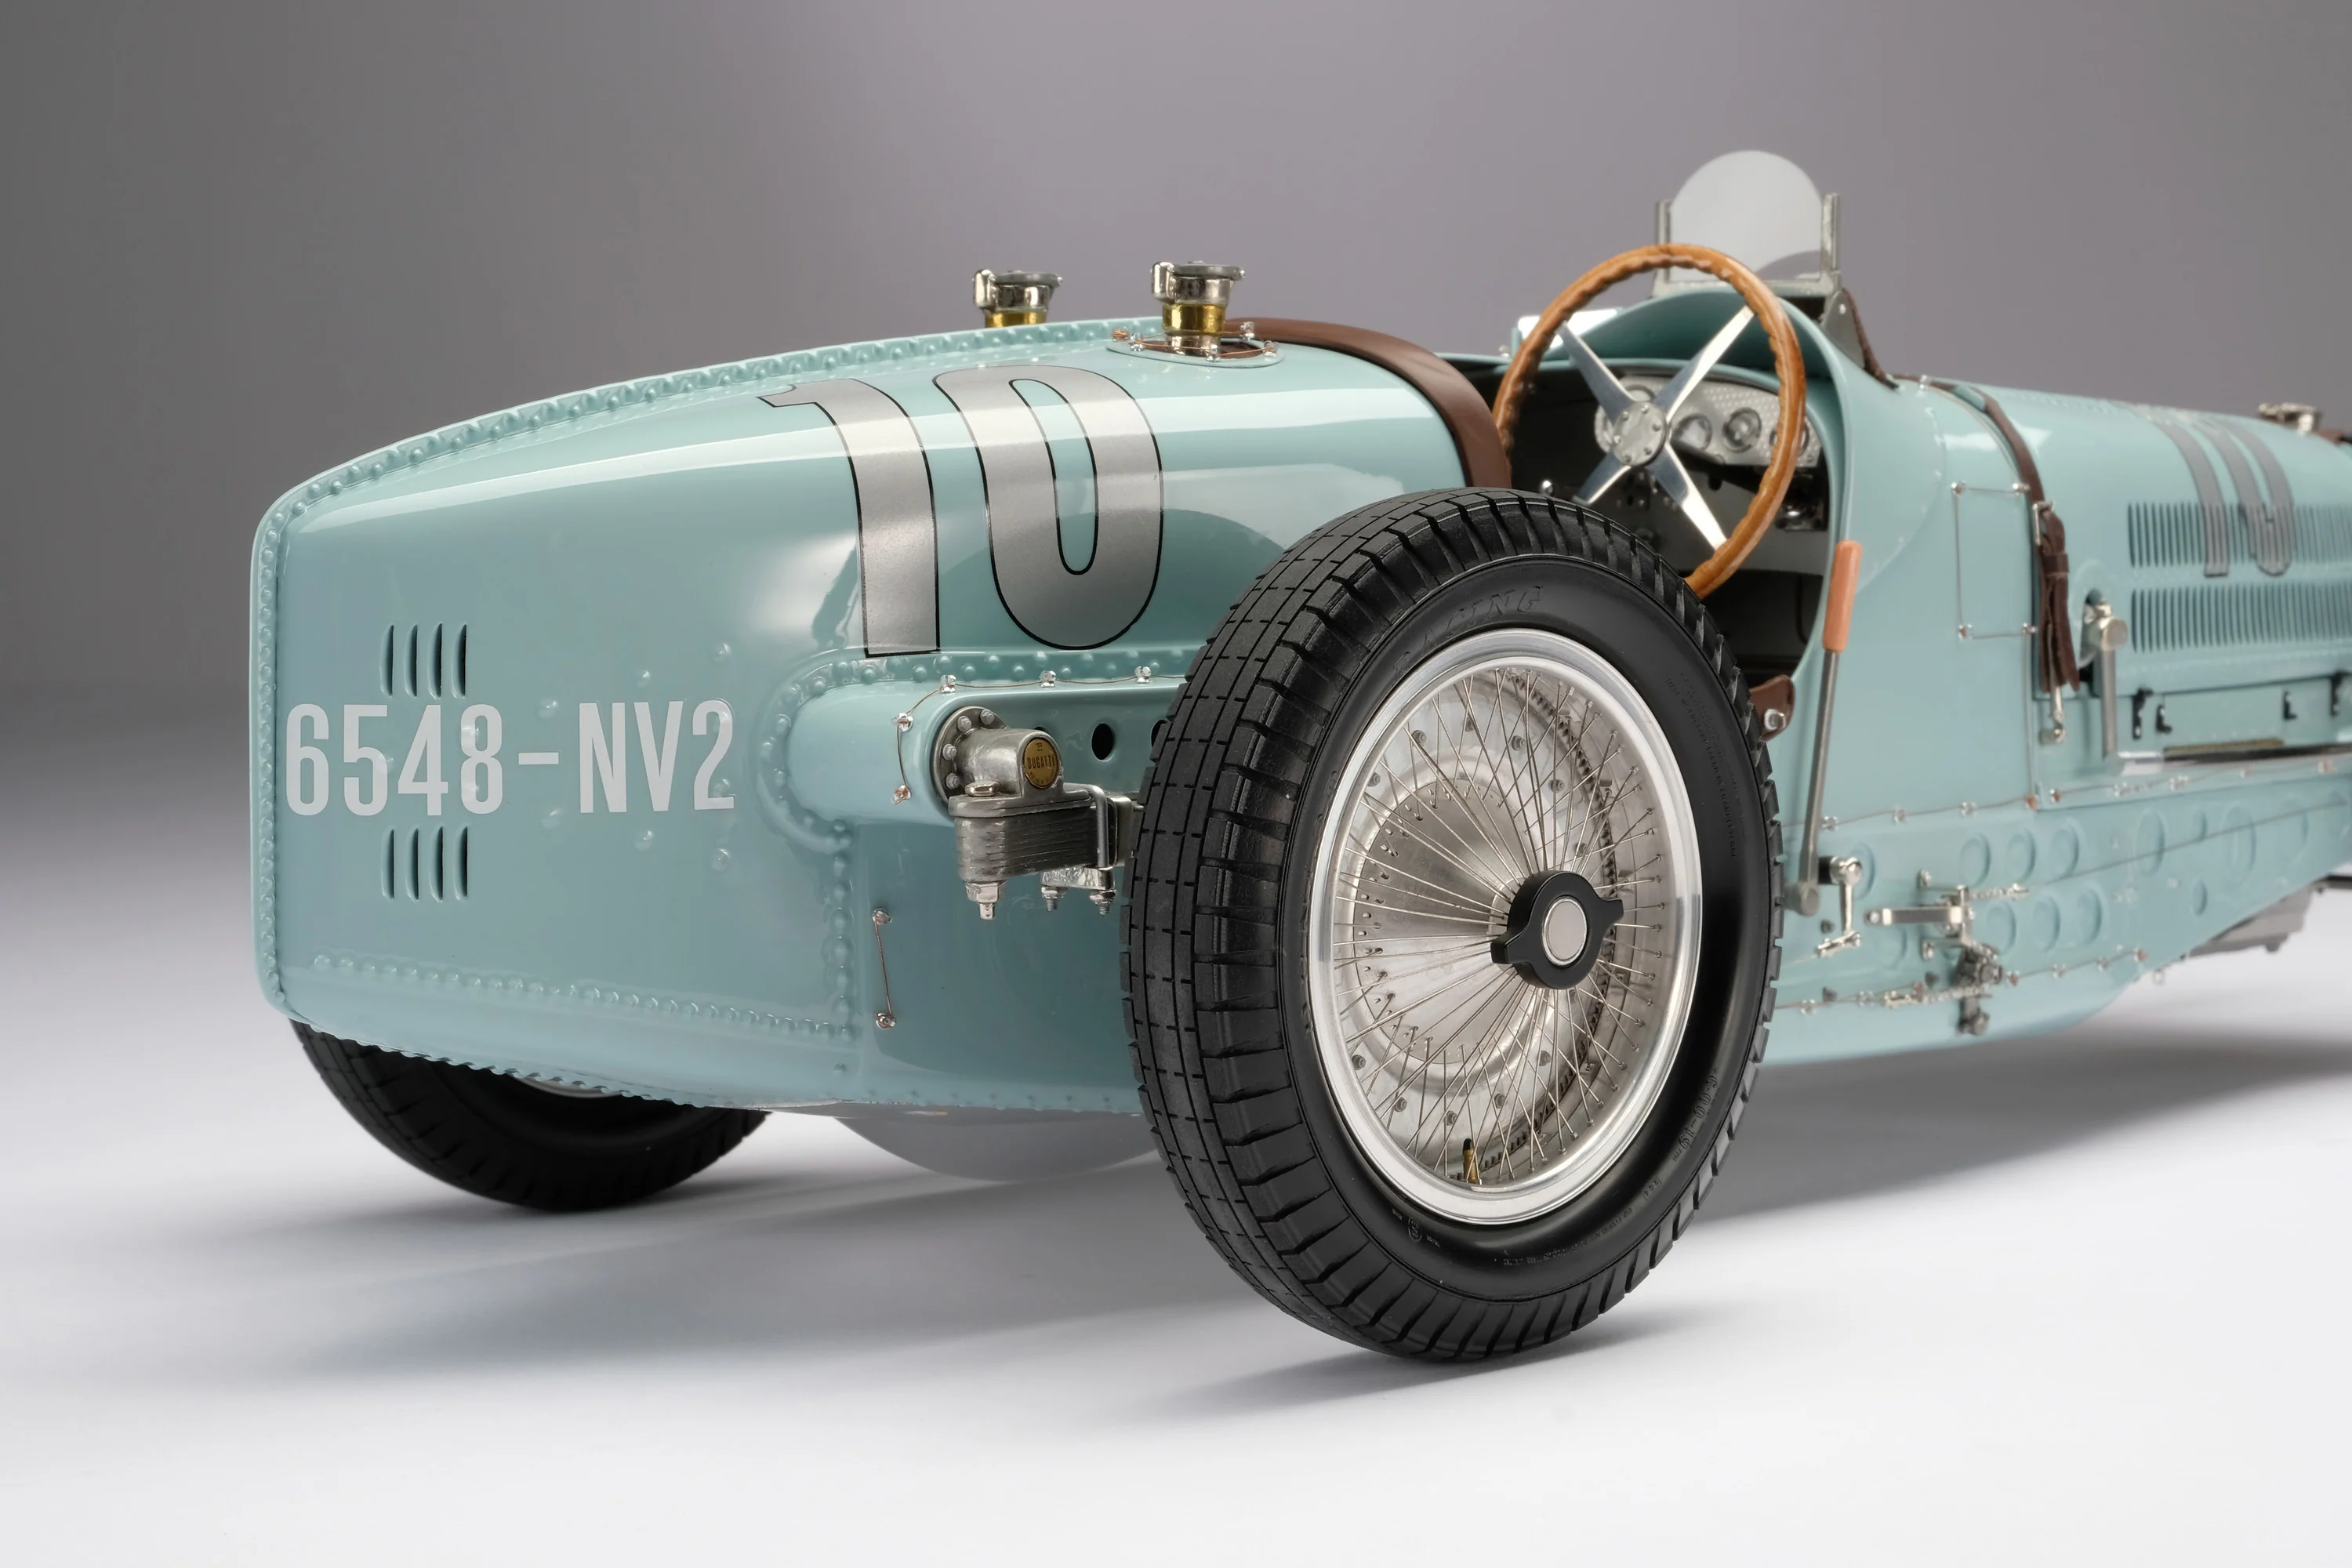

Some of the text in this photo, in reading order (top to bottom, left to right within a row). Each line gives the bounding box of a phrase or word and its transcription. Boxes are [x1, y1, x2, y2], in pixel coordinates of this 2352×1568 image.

[757, 365, 1165, 658] 10
[285, 699, 735, 817] 6548-NV2
[1027, 755, 1055, 769] BUGATTI
